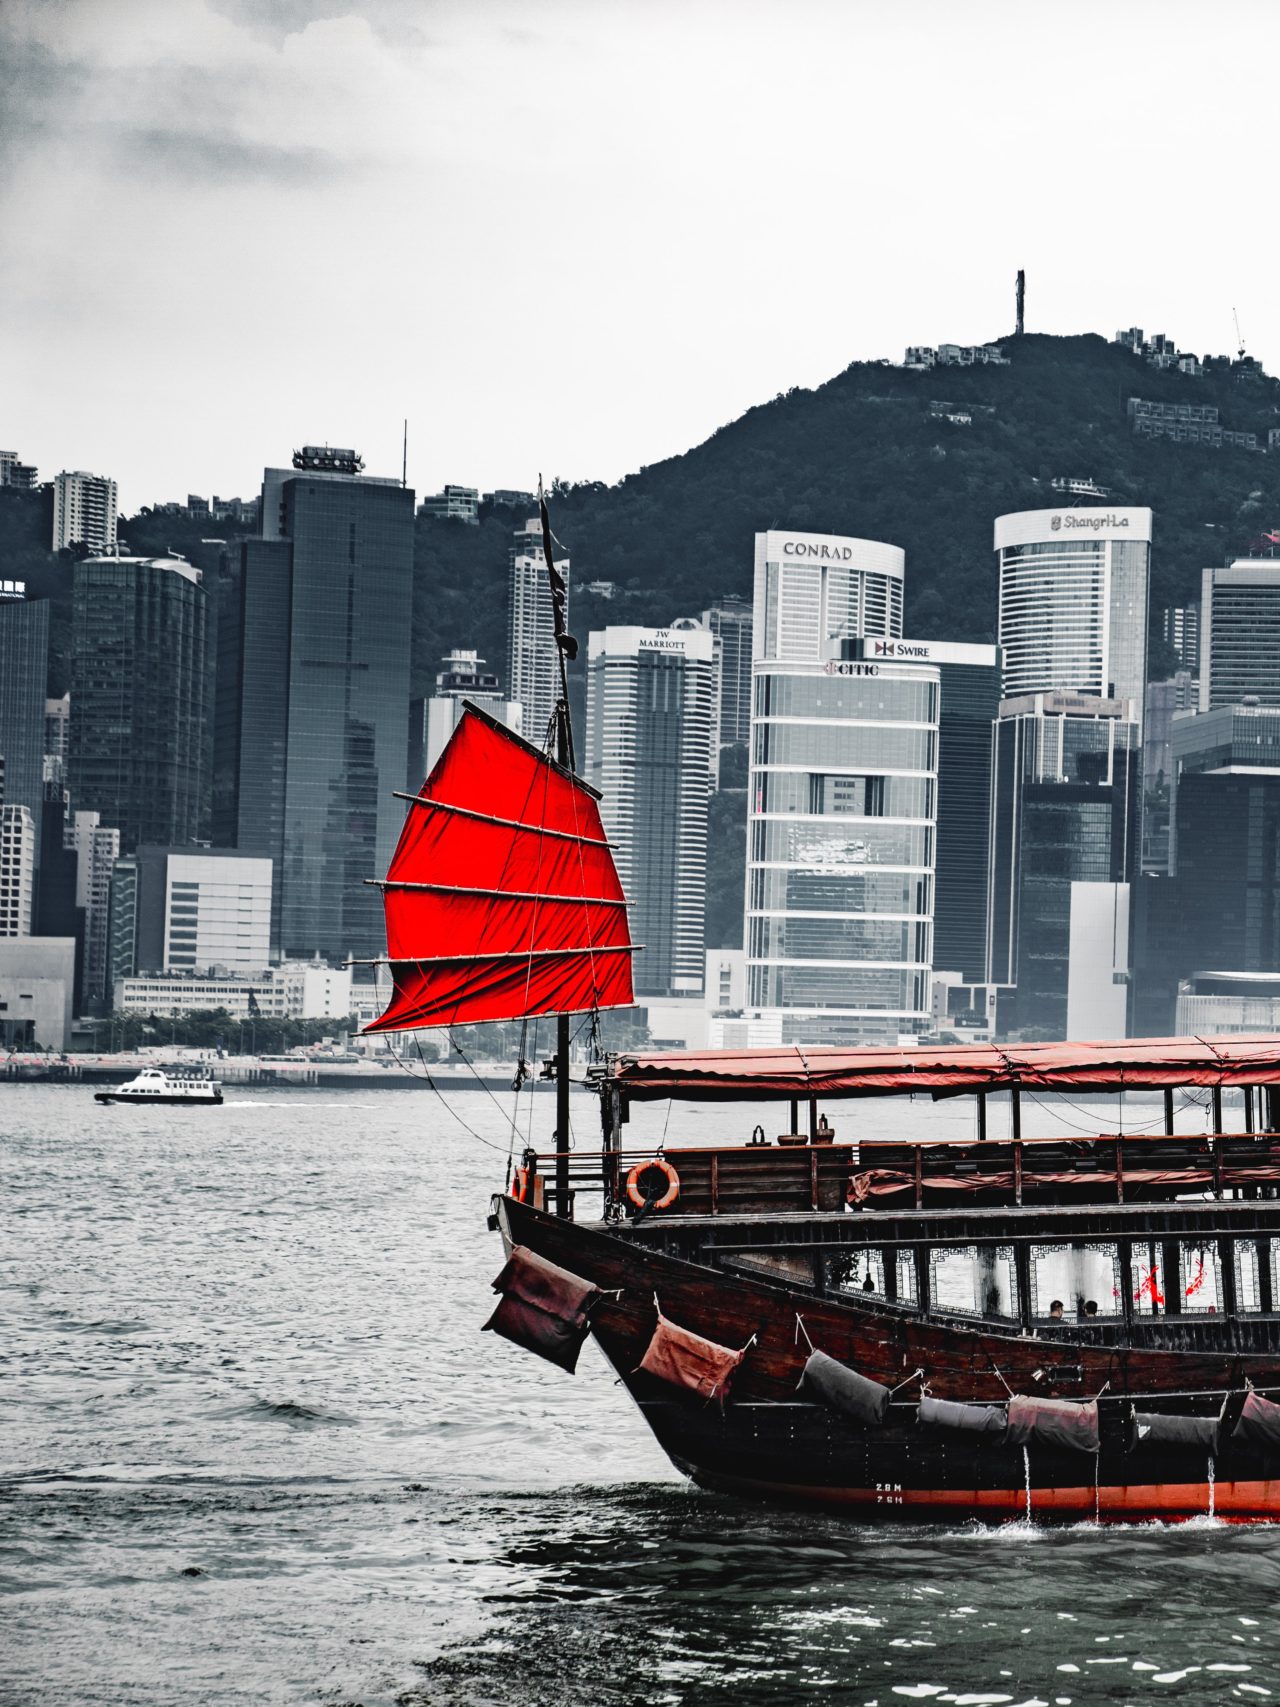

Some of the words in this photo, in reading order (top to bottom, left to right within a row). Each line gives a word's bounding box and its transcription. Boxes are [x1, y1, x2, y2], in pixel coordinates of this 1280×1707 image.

[1064, 514, 1129, 531] Shangri-La
[784, 542, 853, 560] CONRAD
[639, 640, 686, 649] MARRIOTT
[839, 664, 880, 676] CITIC
